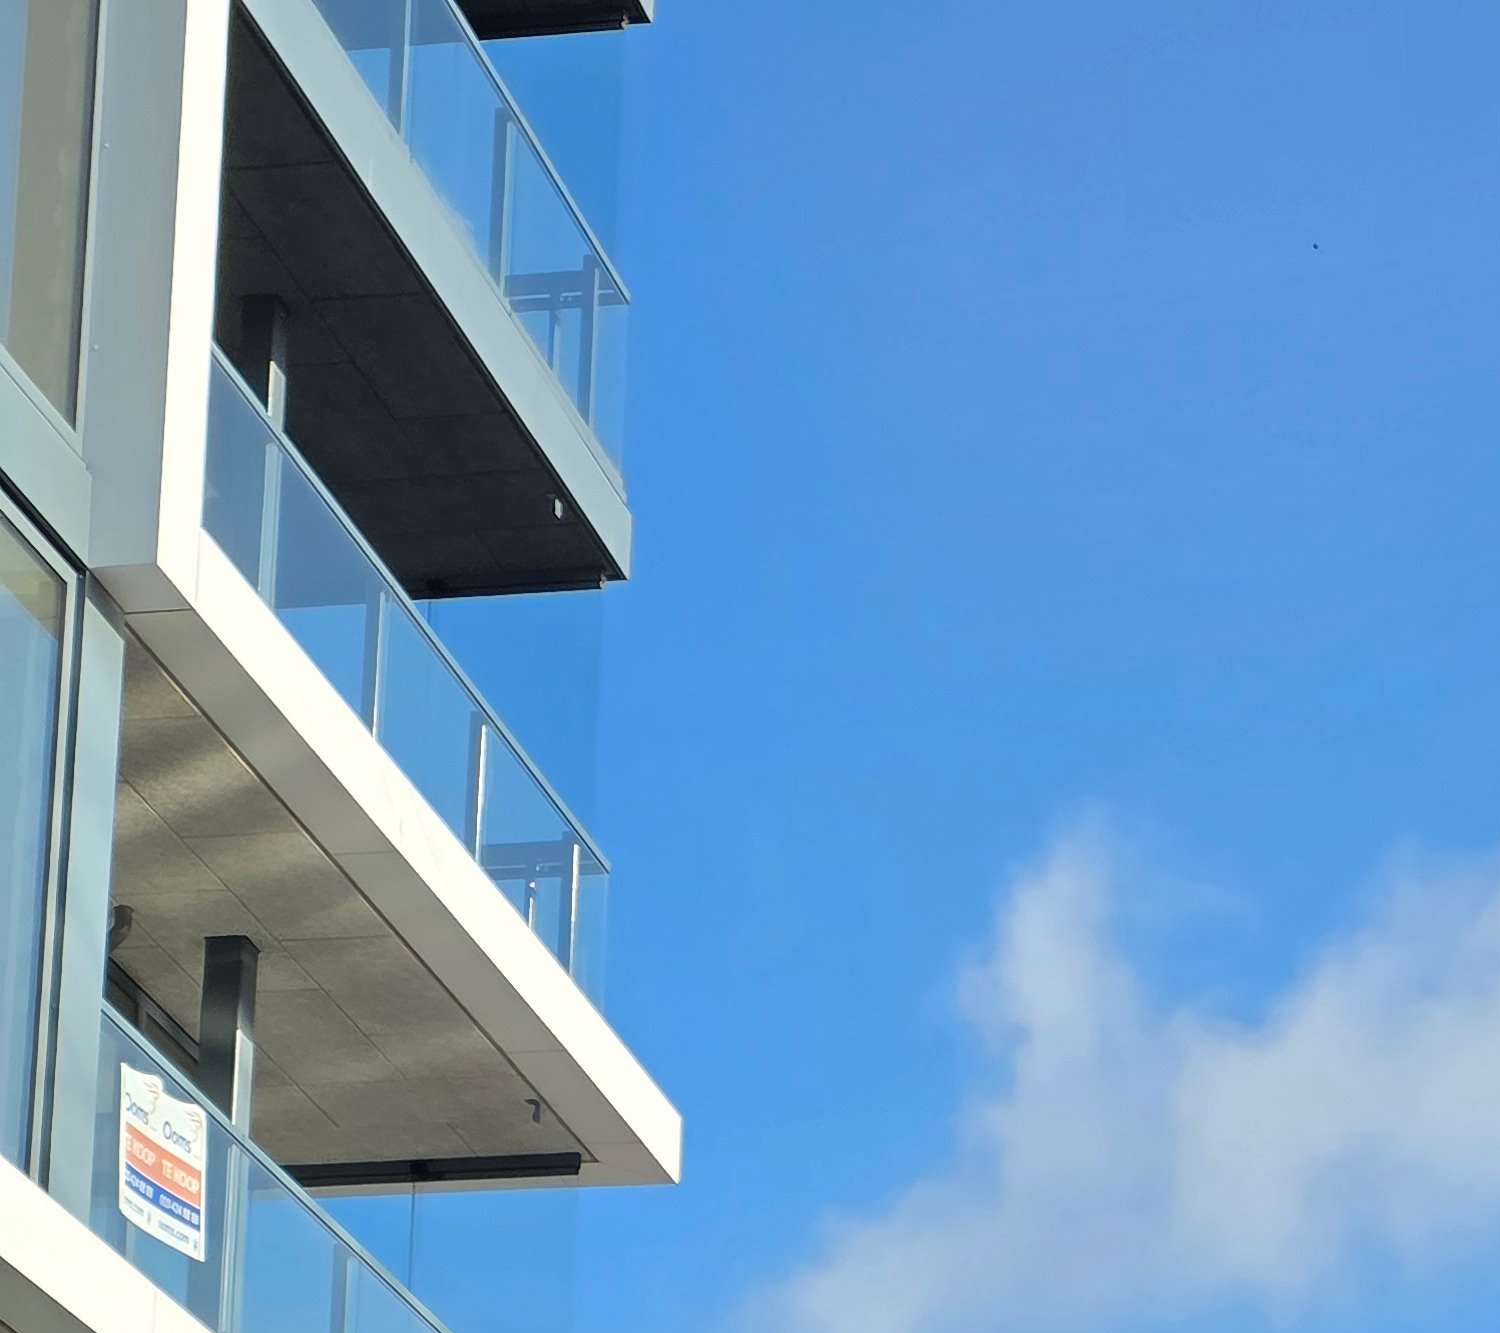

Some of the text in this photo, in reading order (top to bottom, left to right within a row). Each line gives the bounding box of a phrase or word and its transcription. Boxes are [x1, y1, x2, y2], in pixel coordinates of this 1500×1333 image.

[132, 1138, 157, 1167] KOOP
[161, 1158, 174, 1180] TE
[173, 1167, 200, 1194] KOOP
